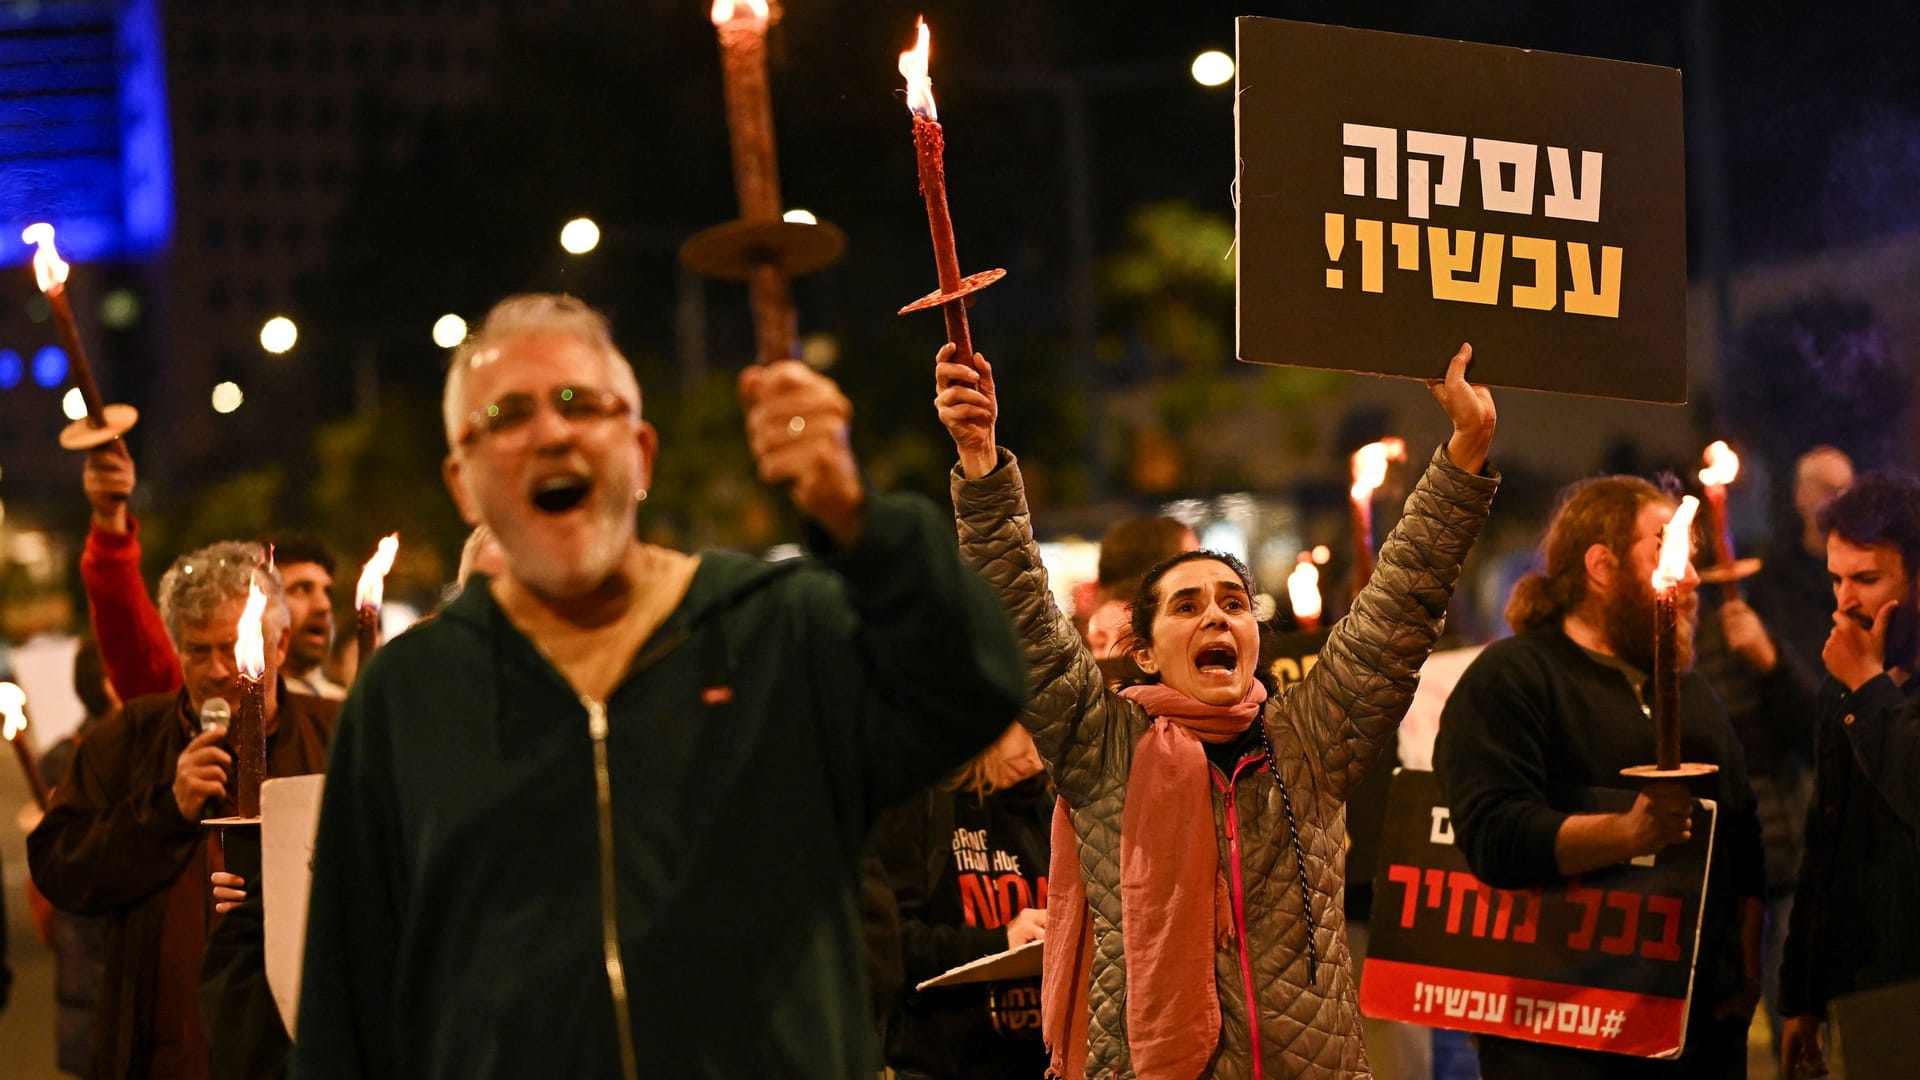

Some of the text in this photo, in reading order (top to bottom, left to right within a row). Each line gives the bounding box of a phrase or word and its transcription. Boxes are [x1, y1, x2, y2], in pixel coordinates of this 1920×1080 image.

[1343, 122, 1603, 223] עסקה
[1324, 212, 1623, 318] עכשיו!
[1388, 864, 1682, 962] בכל מחיר
[1413, 981, 1626, 1039] #עסקה עכשיו!
